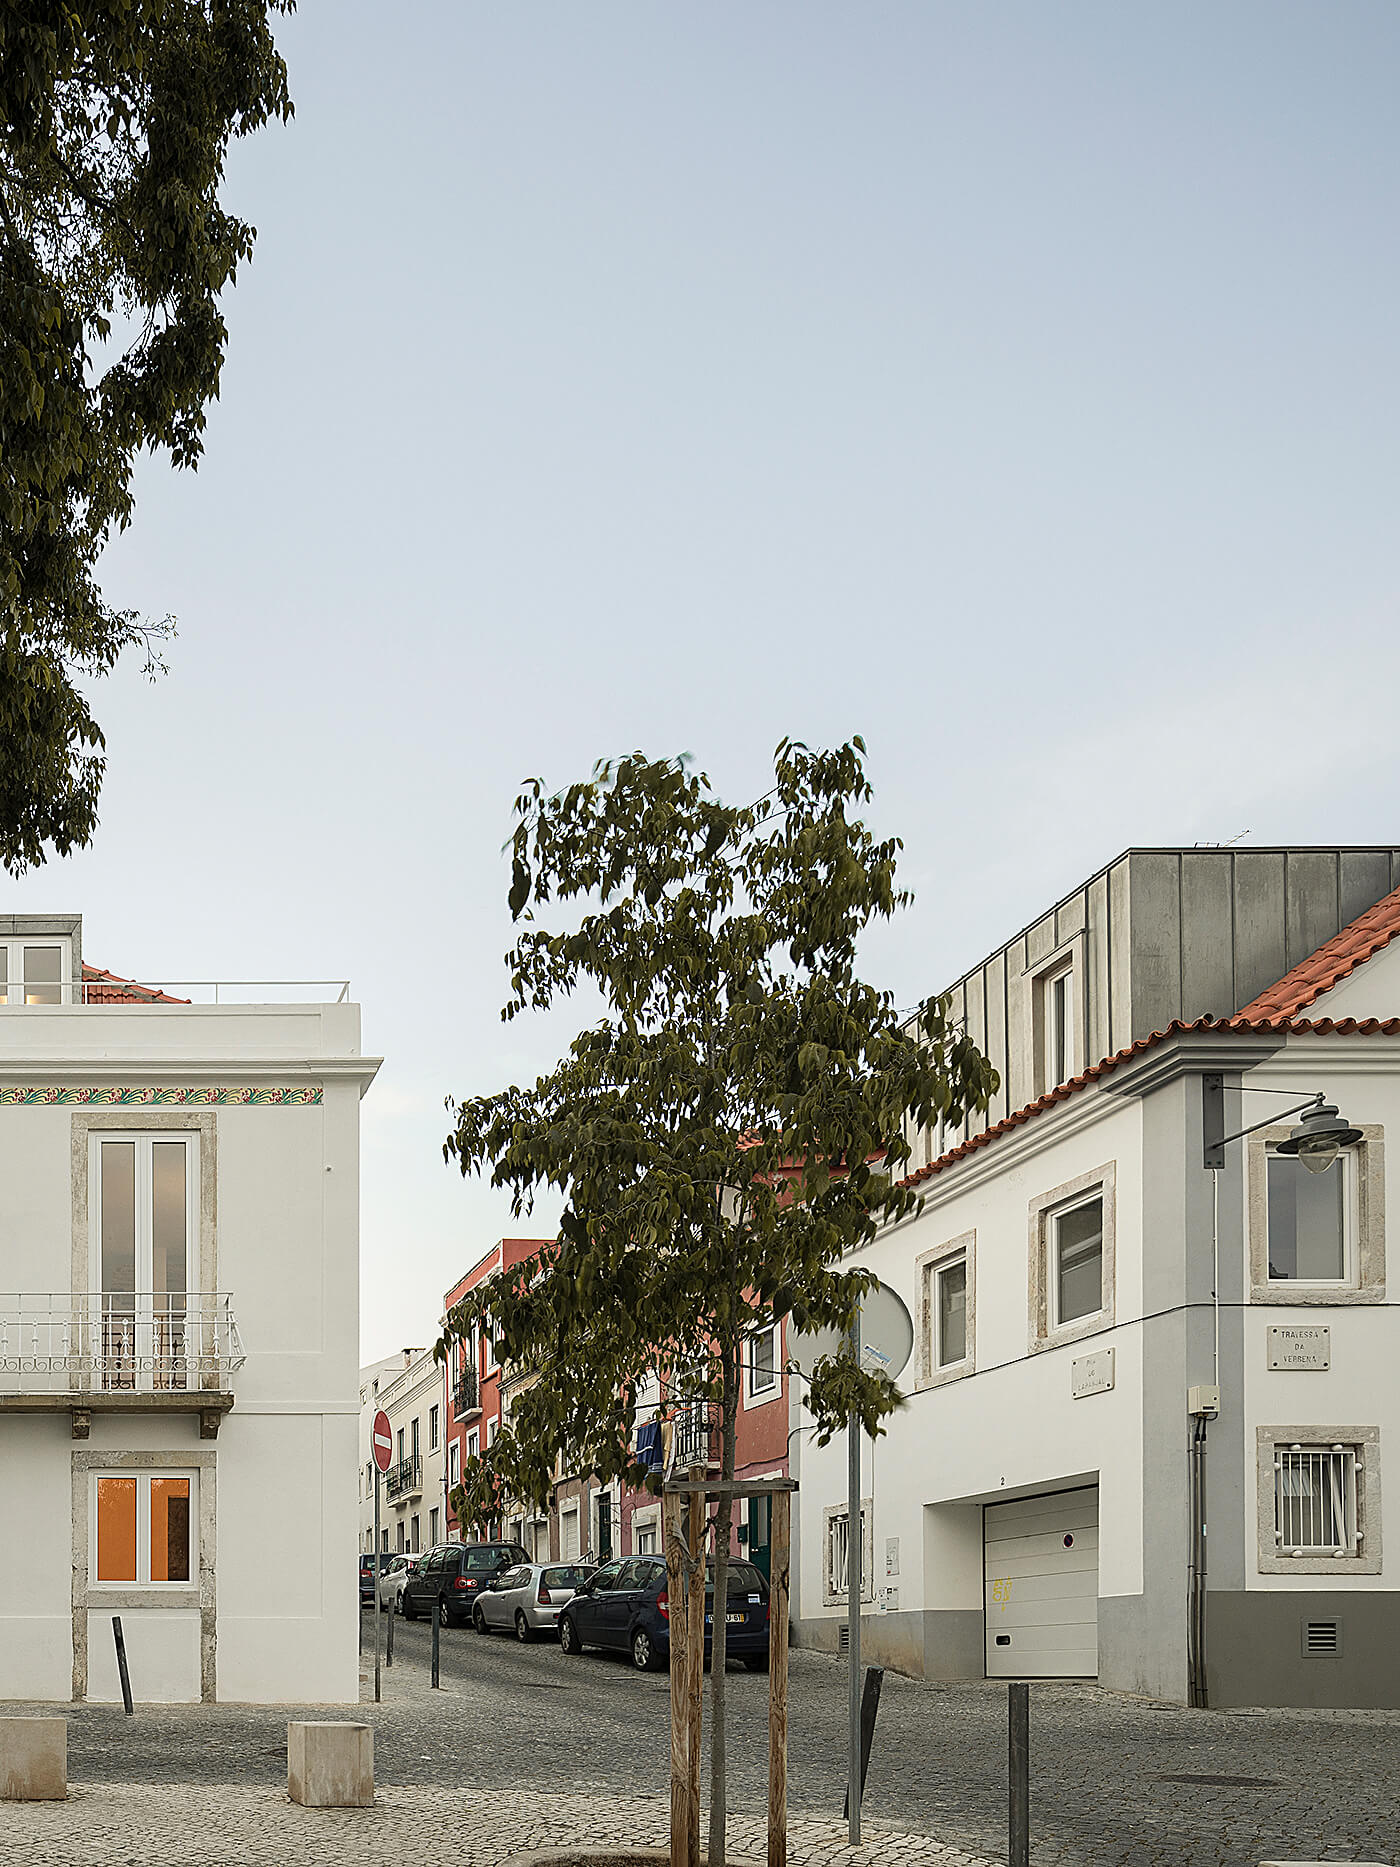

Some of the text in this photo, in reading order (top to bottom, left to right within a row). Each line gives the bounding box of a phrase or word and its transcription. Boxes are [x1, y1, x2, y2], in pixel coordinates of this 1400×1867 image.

[1281, 1330, 1319, 1339] TRAVESSA
[1294, 1343, 1305, 1351] DA
[1000, 1476, 1005, 1485] 2
